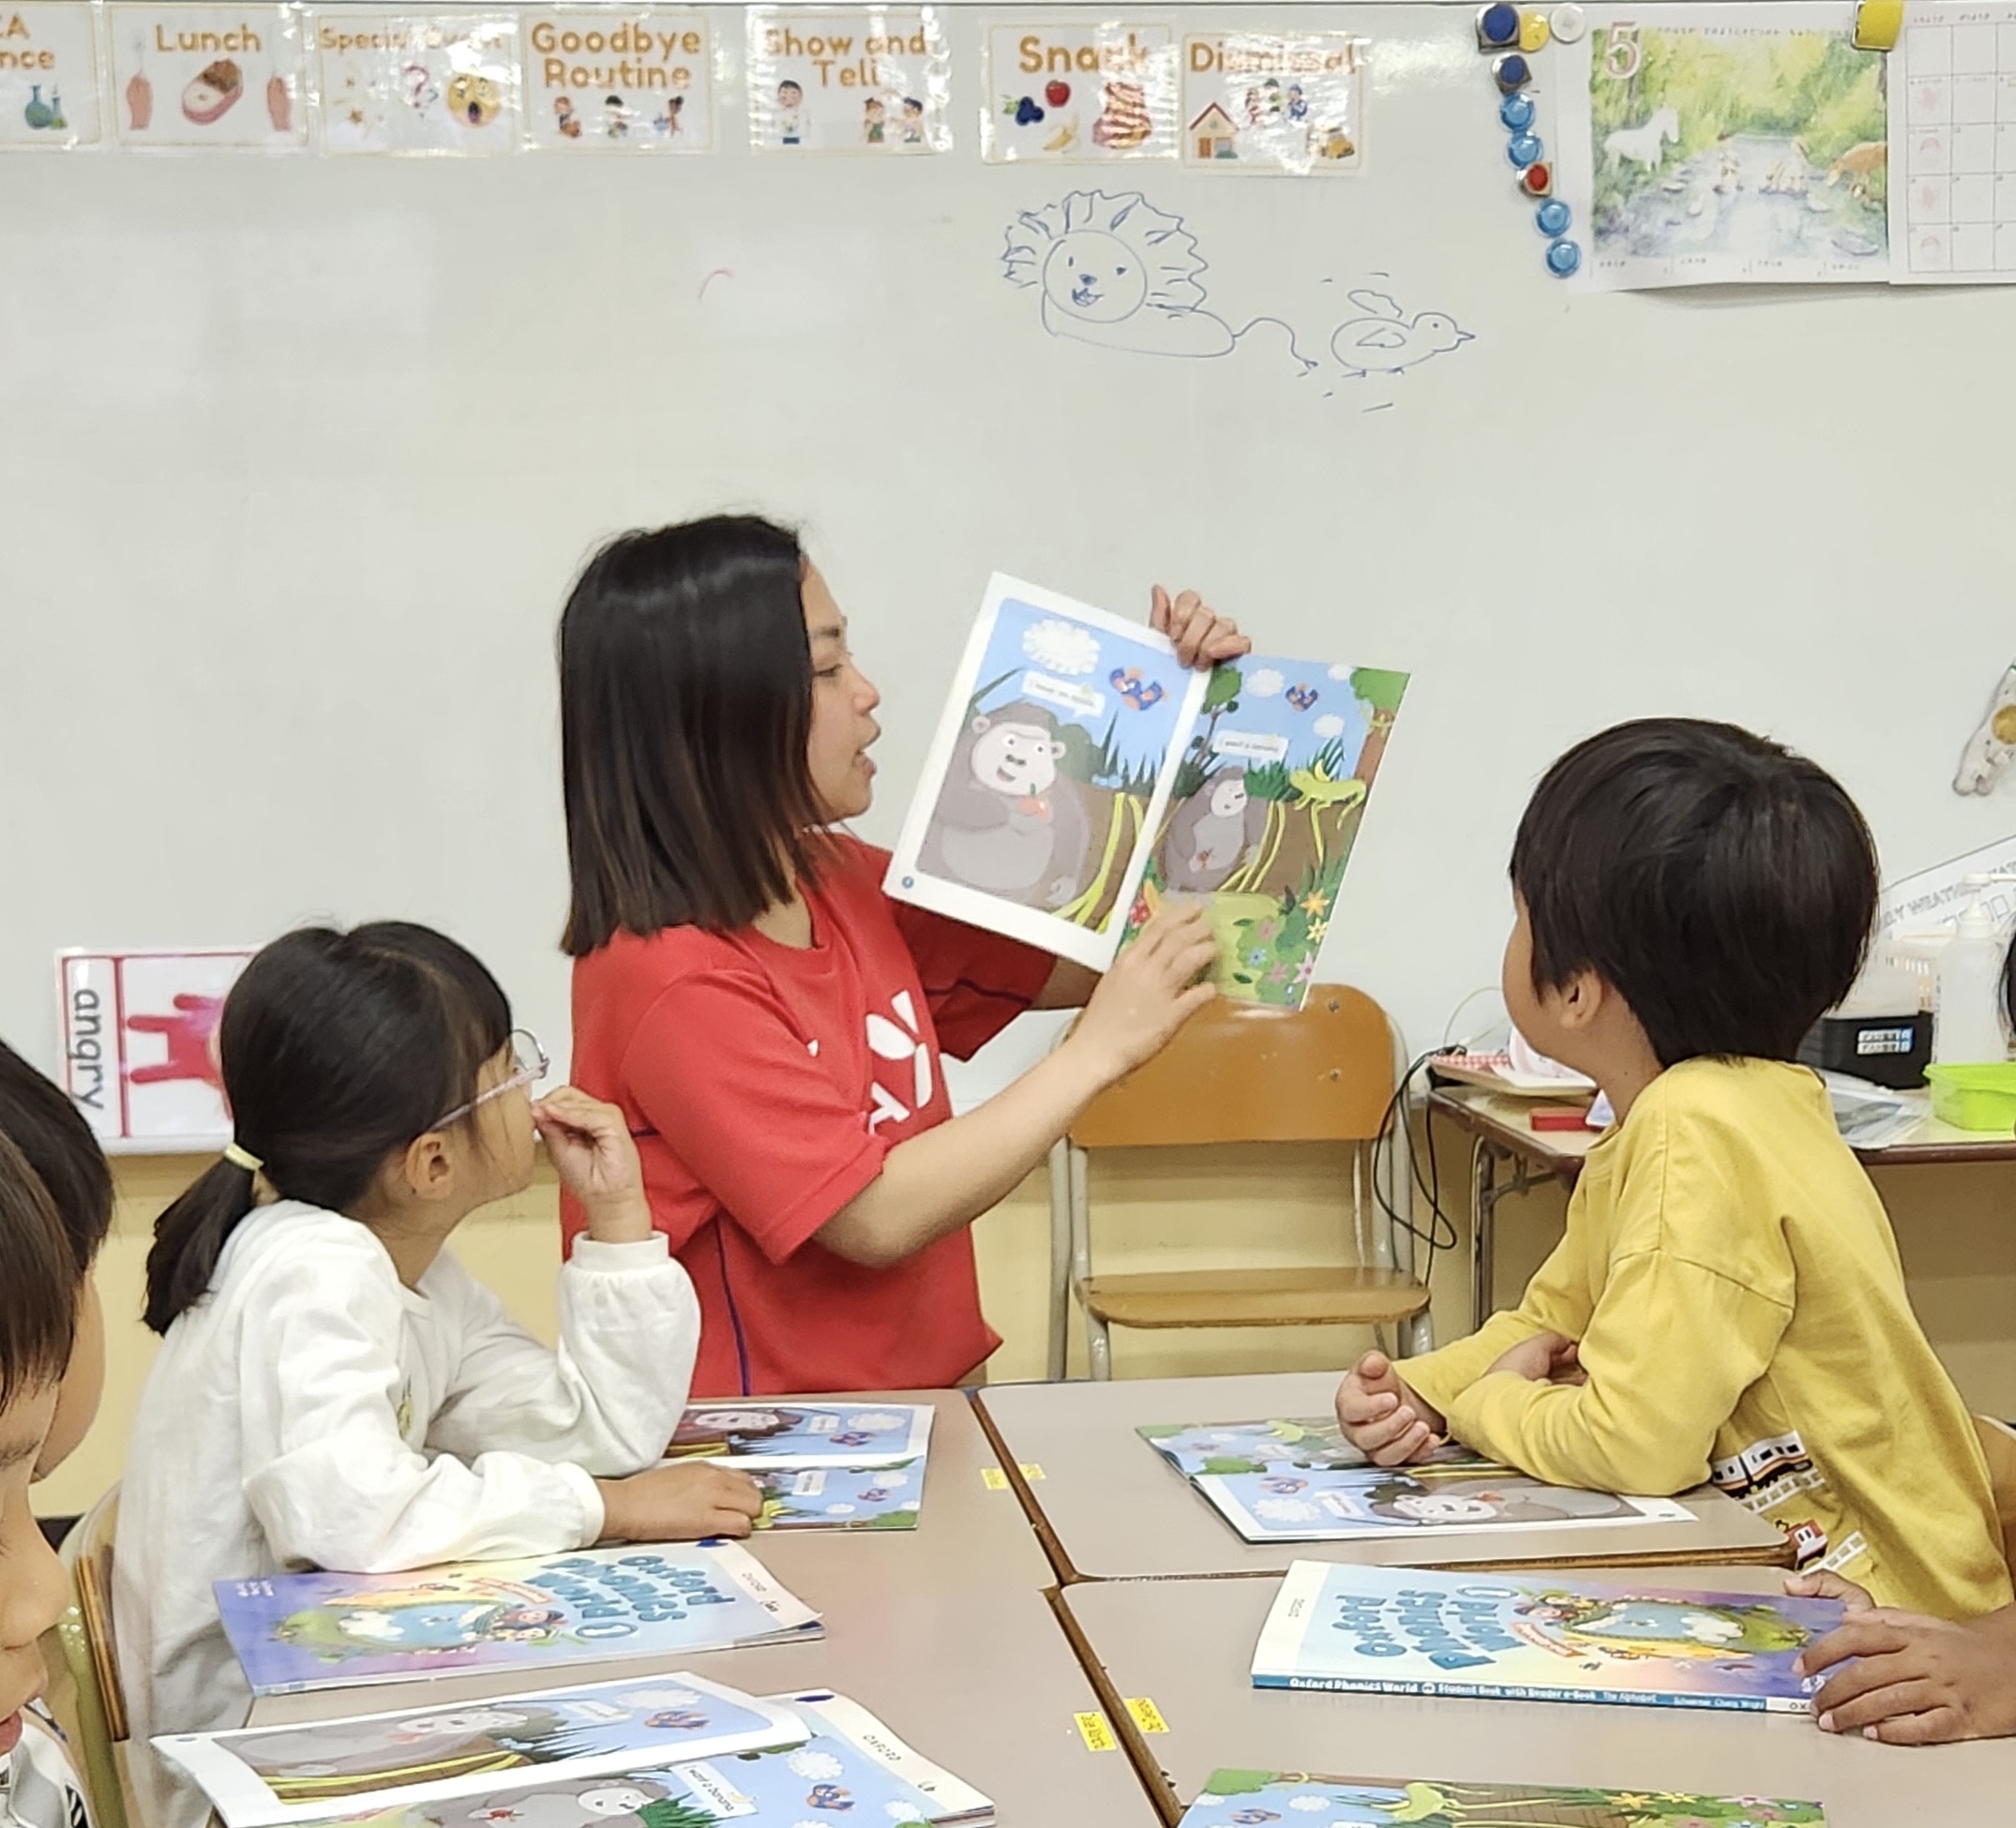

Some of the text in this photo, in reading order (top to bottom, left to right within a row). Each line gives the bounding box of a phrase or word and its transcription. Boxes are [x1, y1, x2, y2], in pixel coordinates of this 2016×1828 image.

[0, 13, 30, 39] A
[155, 22, 262, 52] Lunch
[532, 22, 700, 62] Goodbye
[766, 25, 927, 57] Show and
[0, 50, 54, 69] nce
[1018, 32, 1148, 74] Snack
[1607, 21, 1640, 78] 5
[544, 57, 691, 89] Routine
[67, 989, 104, 1109] angry
[522, 1572, 630, 1619] World
[540, 1558, 687, 1622] Phonics
[619, 1555, 735, 1606] Oxford
[1332, 1595, 1407, 1656] Oxford
[1386, 1590, 1497, 1671] Phonics
[1446, 1600, 1527, 1652] World
[1289, 1676, 1332, 1689] Oxford
[1333, 1678, 1381, 1691] Phonics
[1382, 1682, 1418, 1693] World
[1789, 1701, 1808, 1711] OX
